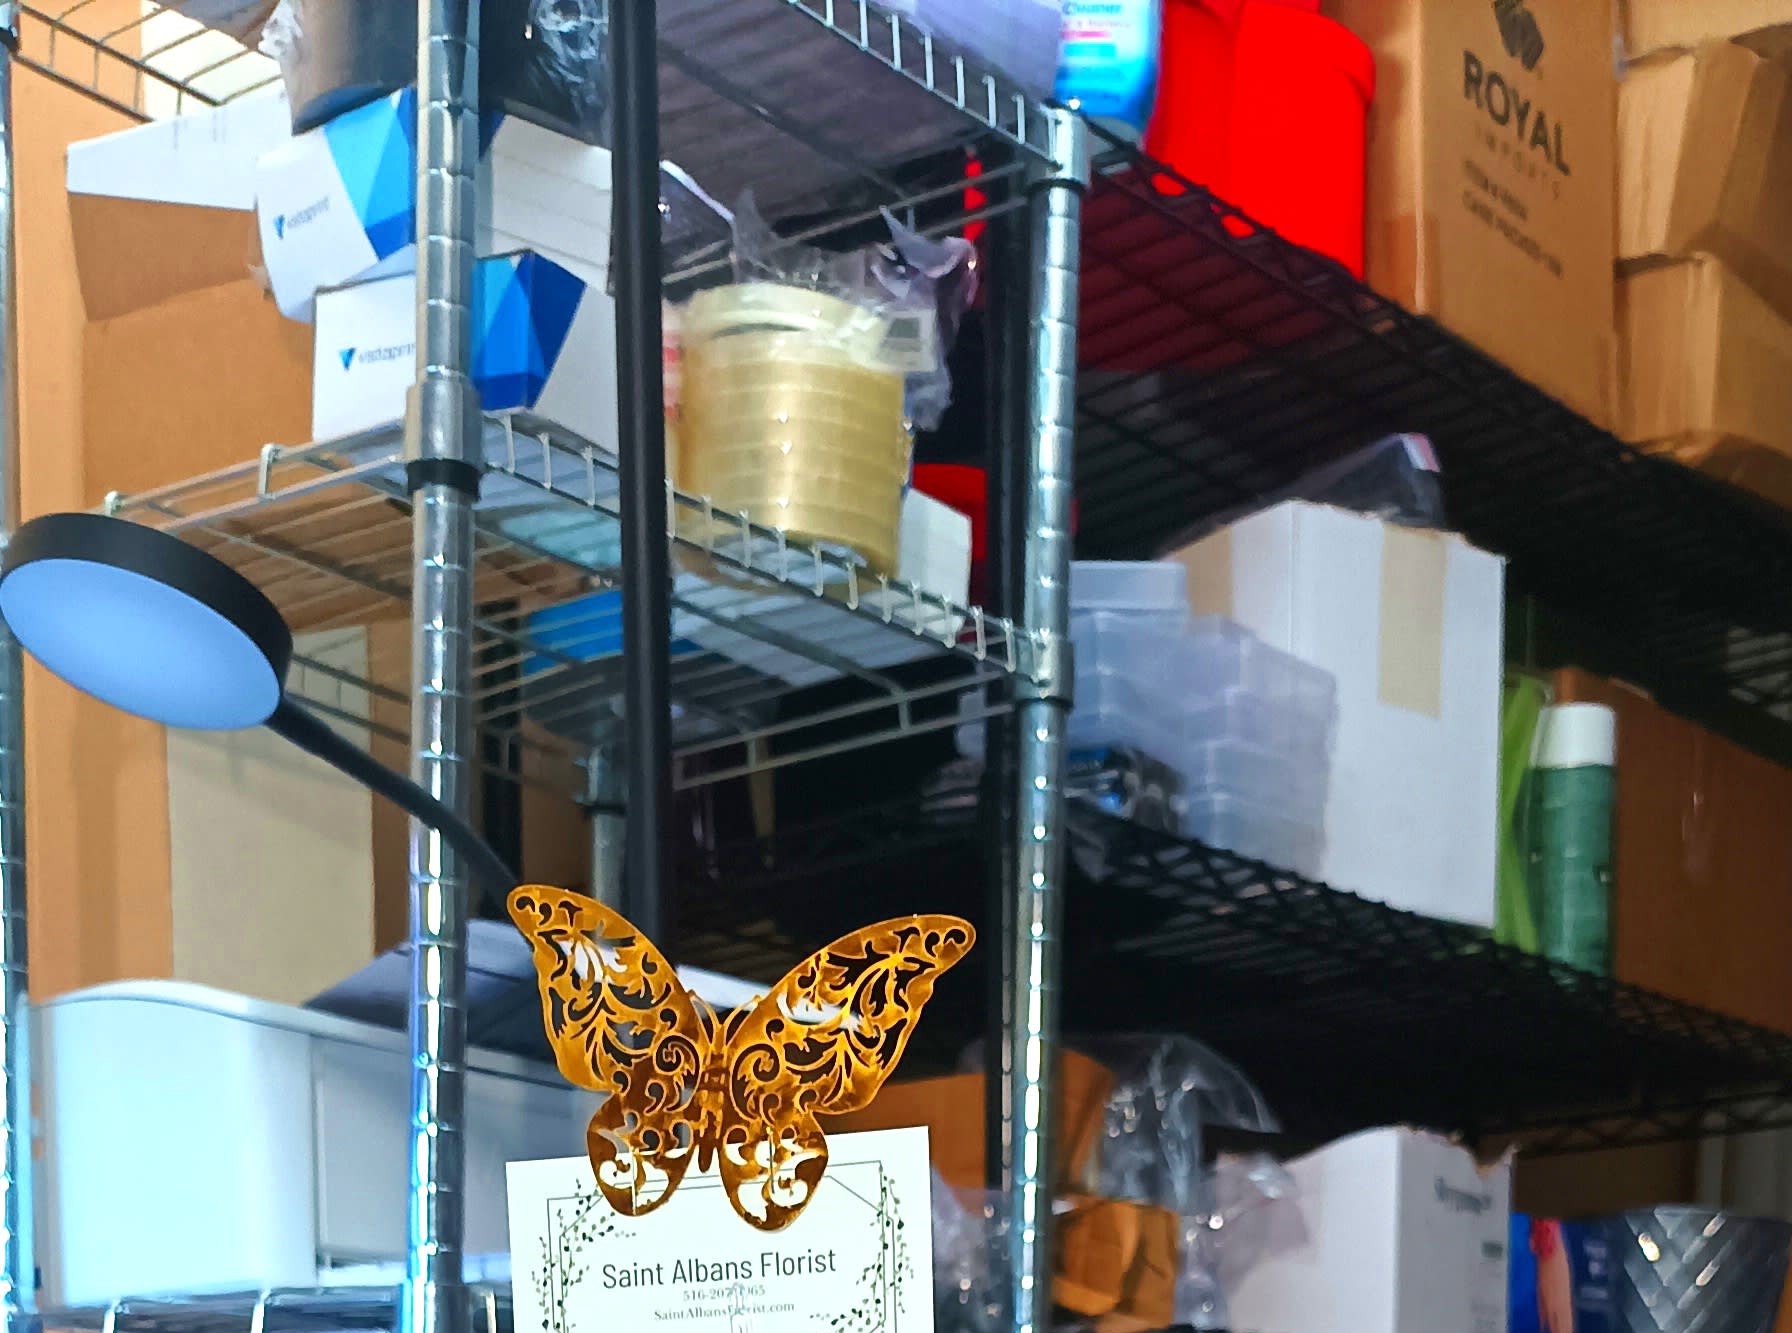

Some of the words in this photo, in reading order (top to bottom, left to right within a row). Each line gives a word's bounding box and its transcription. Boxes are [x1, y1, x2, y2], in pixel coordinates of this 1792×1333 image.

[1463, 49, 1571, 176] ROYAL
[358, 342, 417, 364] vistapri
[602, 1261, 665, 1289] Saint
[672, 1258, 753, 1284] Albans
[760, 1249, 837, 1277] Florist
